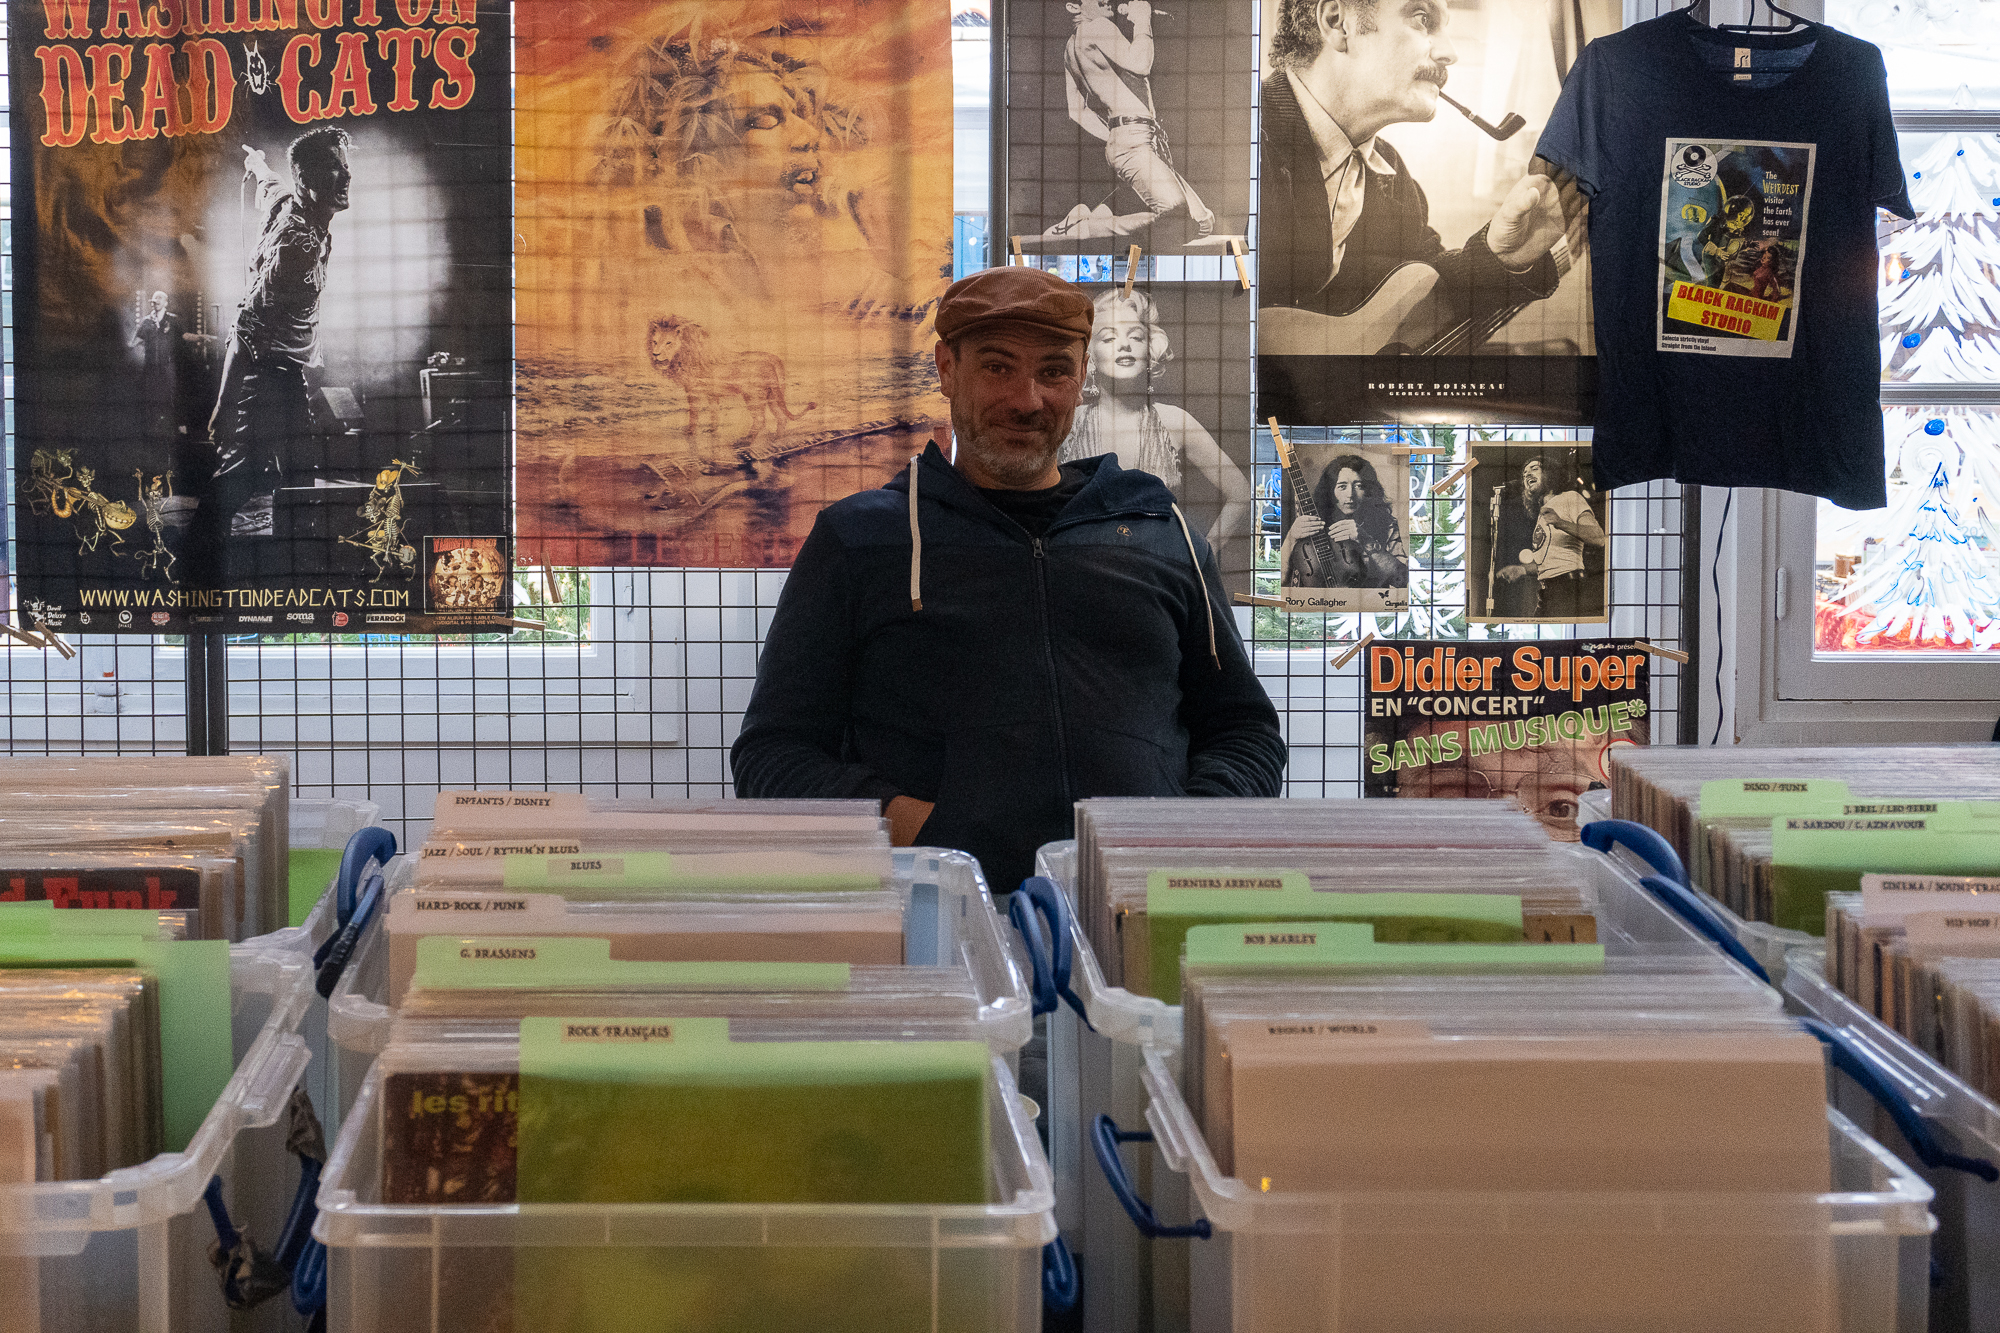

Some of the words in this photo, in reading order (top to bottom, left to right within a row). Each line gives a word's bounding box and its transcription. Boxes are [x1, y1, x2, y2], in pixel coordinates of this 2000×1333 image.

[34, 39, 238, 147] DEAD
[276, 27, 481, 124] CATS
[1765, 171, 1778, 180] The
[1762, 179, 1800, 196] WEIRDEST
[1763, 196, 1785, 205] visitor
[1763, 206, 1775, 215] the
[1775, 206, 1793, 216] Earth
[1762, 216, 1774, 225] has
[1775, 219, 1790, 227] ever
[1762, 228, 1780, 237] seen!
[1677, 284, 1724, 308] BLACK
[1725, 295, 1780, 321] RACKAM
[1700, 310, 1752, 334] STUDIO
[79, 588, 409, 608] WWW.WASHINGTONDEADCATS.COM
[1285, 597, 1305, 608] Rory
[1308, 597, 1347, 608] Gallagher
[46, 604, 62, 612] Devil
[286, 612, 315, 621] soma
[366, 613, 405, 622] FERAROCK
[1370, 646, 1501, 693] Didier
[1511, 646, 1645, 702] Super
[1371, 698, 1402, 717] EN
[1369, 731, 1463, 774] SANS
[455, 797, 504, 806] ENFANTS
[513, 798, 551, 806] DISNEY
[1787, 820, 1800, 829] M.
[1803, 820, 1845, 829] SARDOU
[1866, 820, 1925, 829] AZNAVOUR
[422, 848, 446, 859] JAZZ
[457, 847, 483, 856] SOUL
[494, 844, 545, 856] RYTHM'N
[549, 845, 579, 854] BLUES
[570, 861, 602, 870] BLUES
[1168, 879, 1221, 889] DERNIERS
[1225, 879, 1283, 889] ARRIVAGES
[417, 900, 483, 911] HARD-ROCK
[493, 901, 526, 911] PUNK
[1244, 934, 1266, 945] BOB
[1269, 934, 1317, 945] MARLEY
[460, 948, 471, 959] G.
[475, 949, 537, 959] BRASSENS
[567, 1026, 598, 1037] ROCK
[602, 1026, 669, 1040] FRANÇAIS
[1328, 1025, 1378, 1034] WORLD
[411, 1091, 469, 1114] les
[478, 1088, 519, 1113] rit
